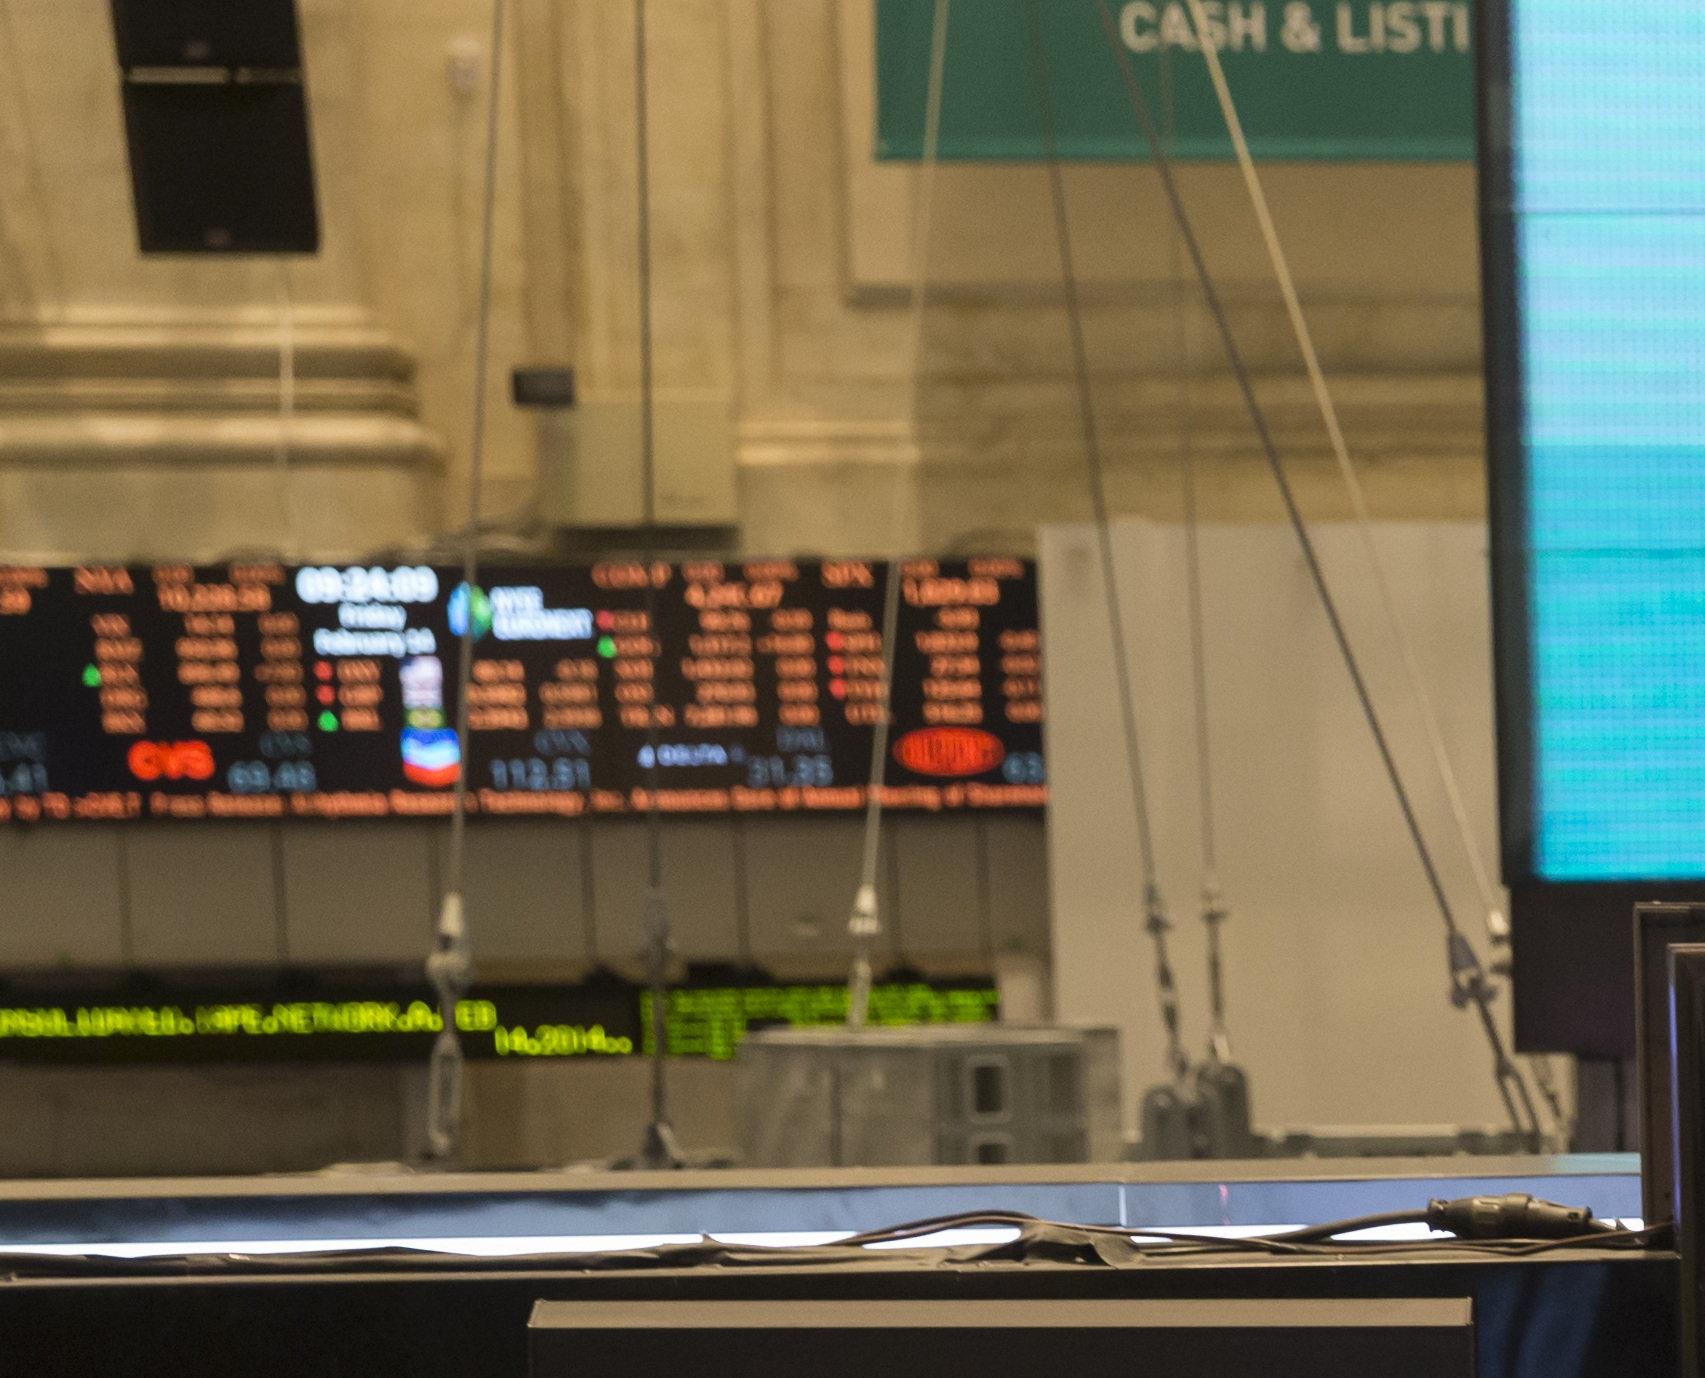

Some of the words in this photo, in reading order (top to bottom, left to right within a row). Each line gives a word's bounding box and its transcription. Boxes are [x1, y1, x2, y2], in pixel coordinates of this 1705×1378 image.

[1119, 2, 1267, 53] CASH
[1280, 1, 1320, 53] &
[1335, 2, 1470, 54] LISTI
